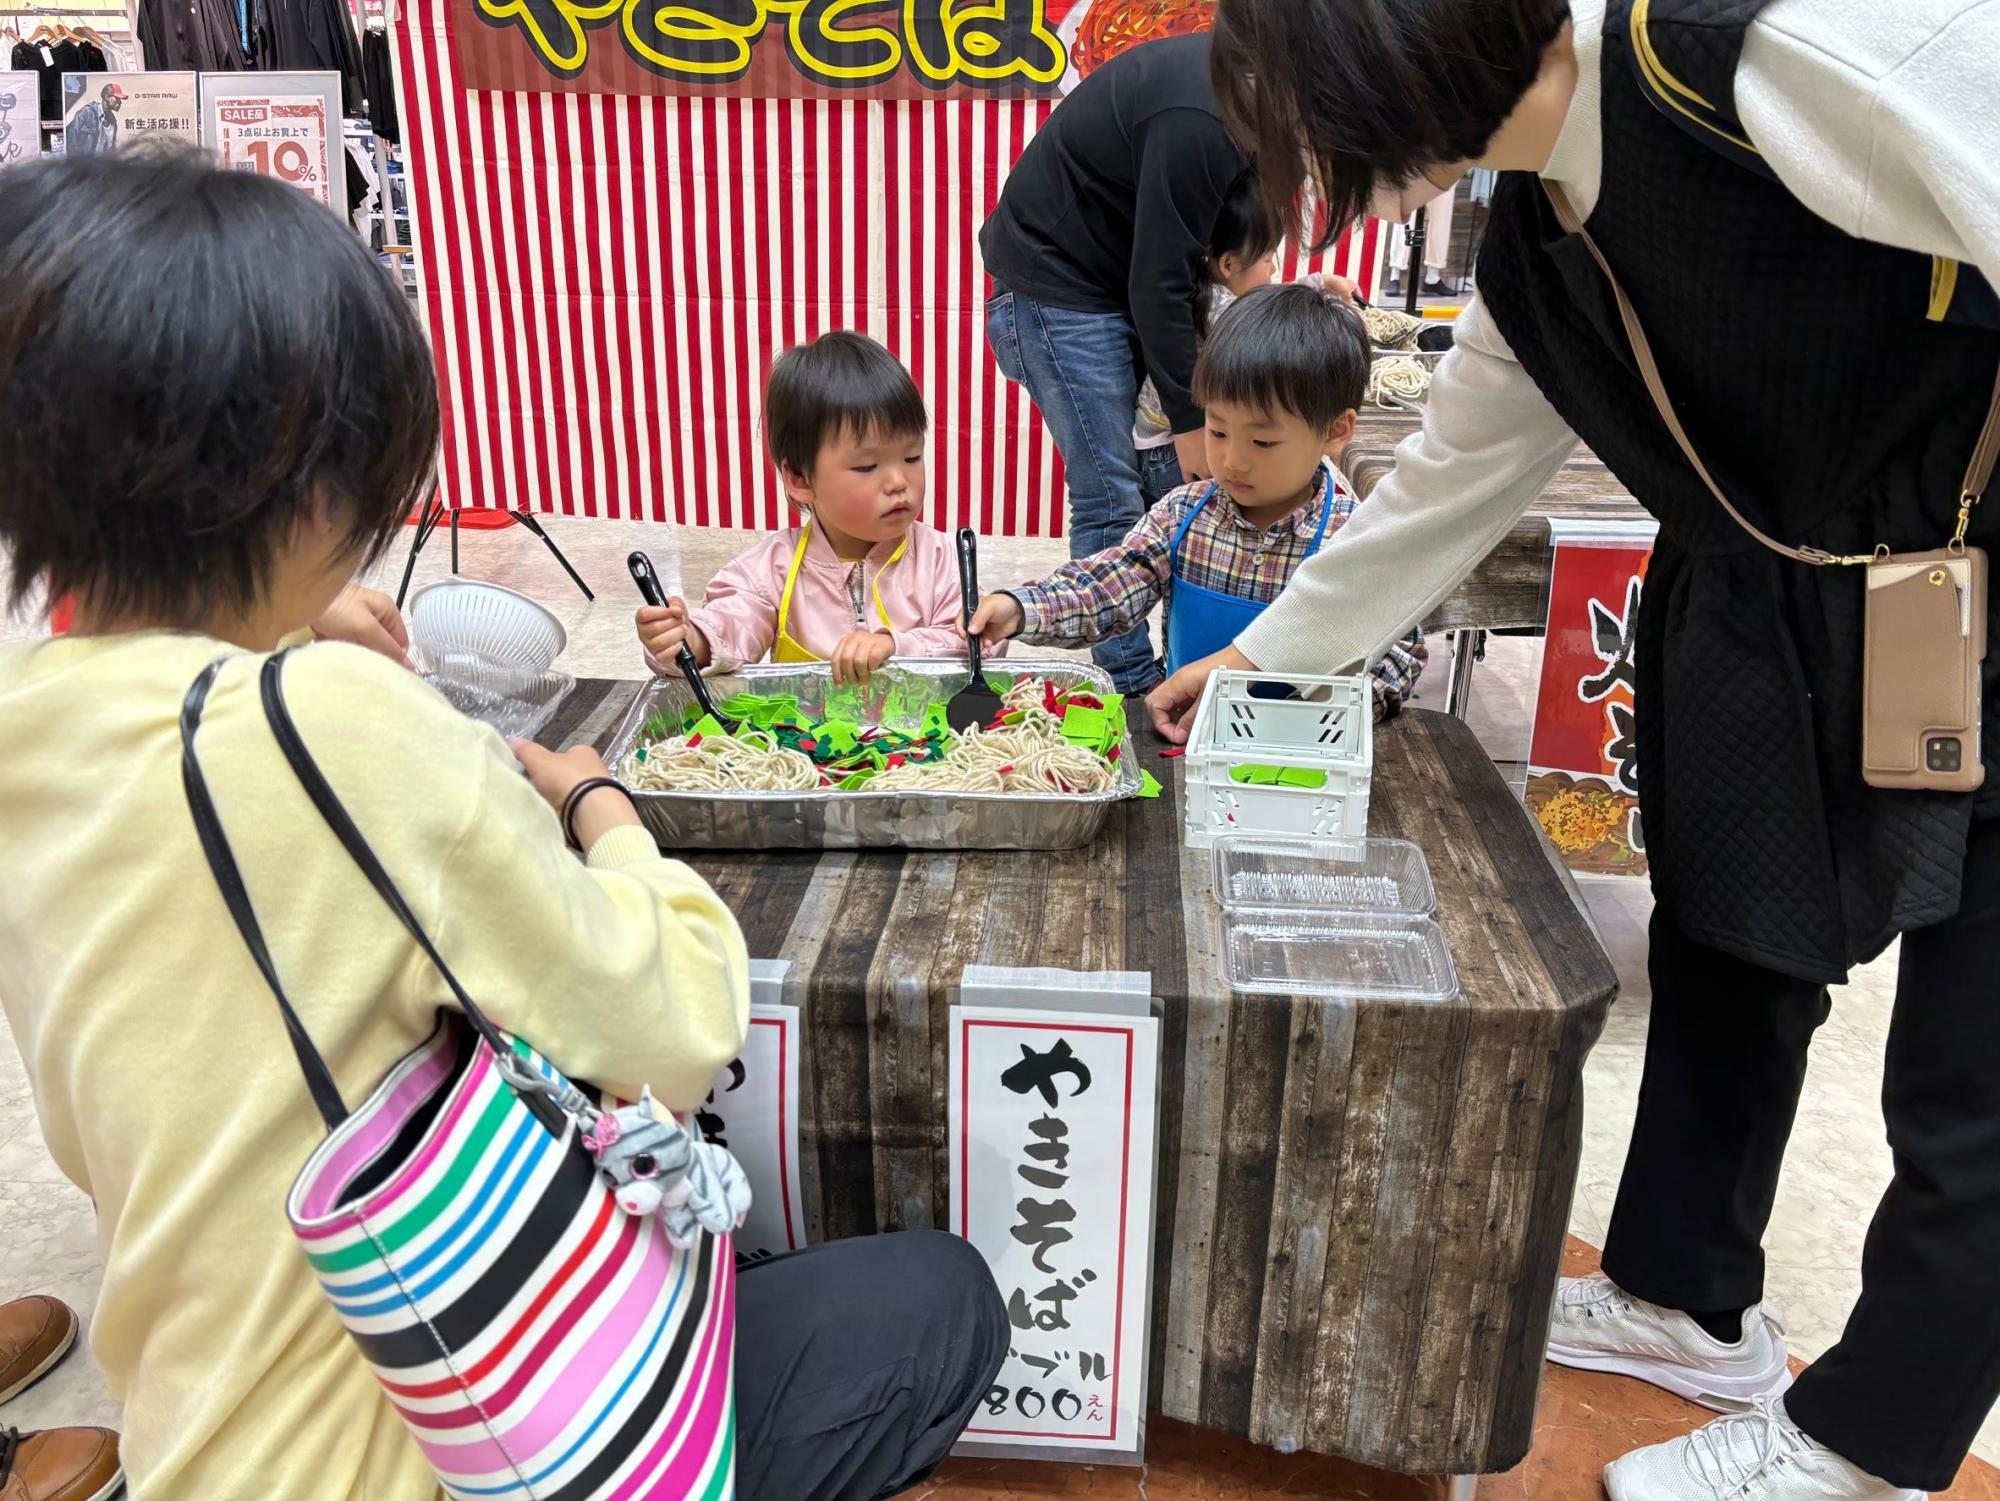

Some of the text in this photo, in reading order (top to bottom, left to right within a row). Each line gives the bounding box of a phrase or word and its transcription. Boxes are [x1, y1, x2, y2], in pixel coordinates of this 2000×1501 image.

[224, 109, 264, 120] SALE品
[1001, 1037, 1098, 1331] やきそば
[1006, 1347, 1112, 1382] ブル
[983, 1384, 1082, 1421] 800
